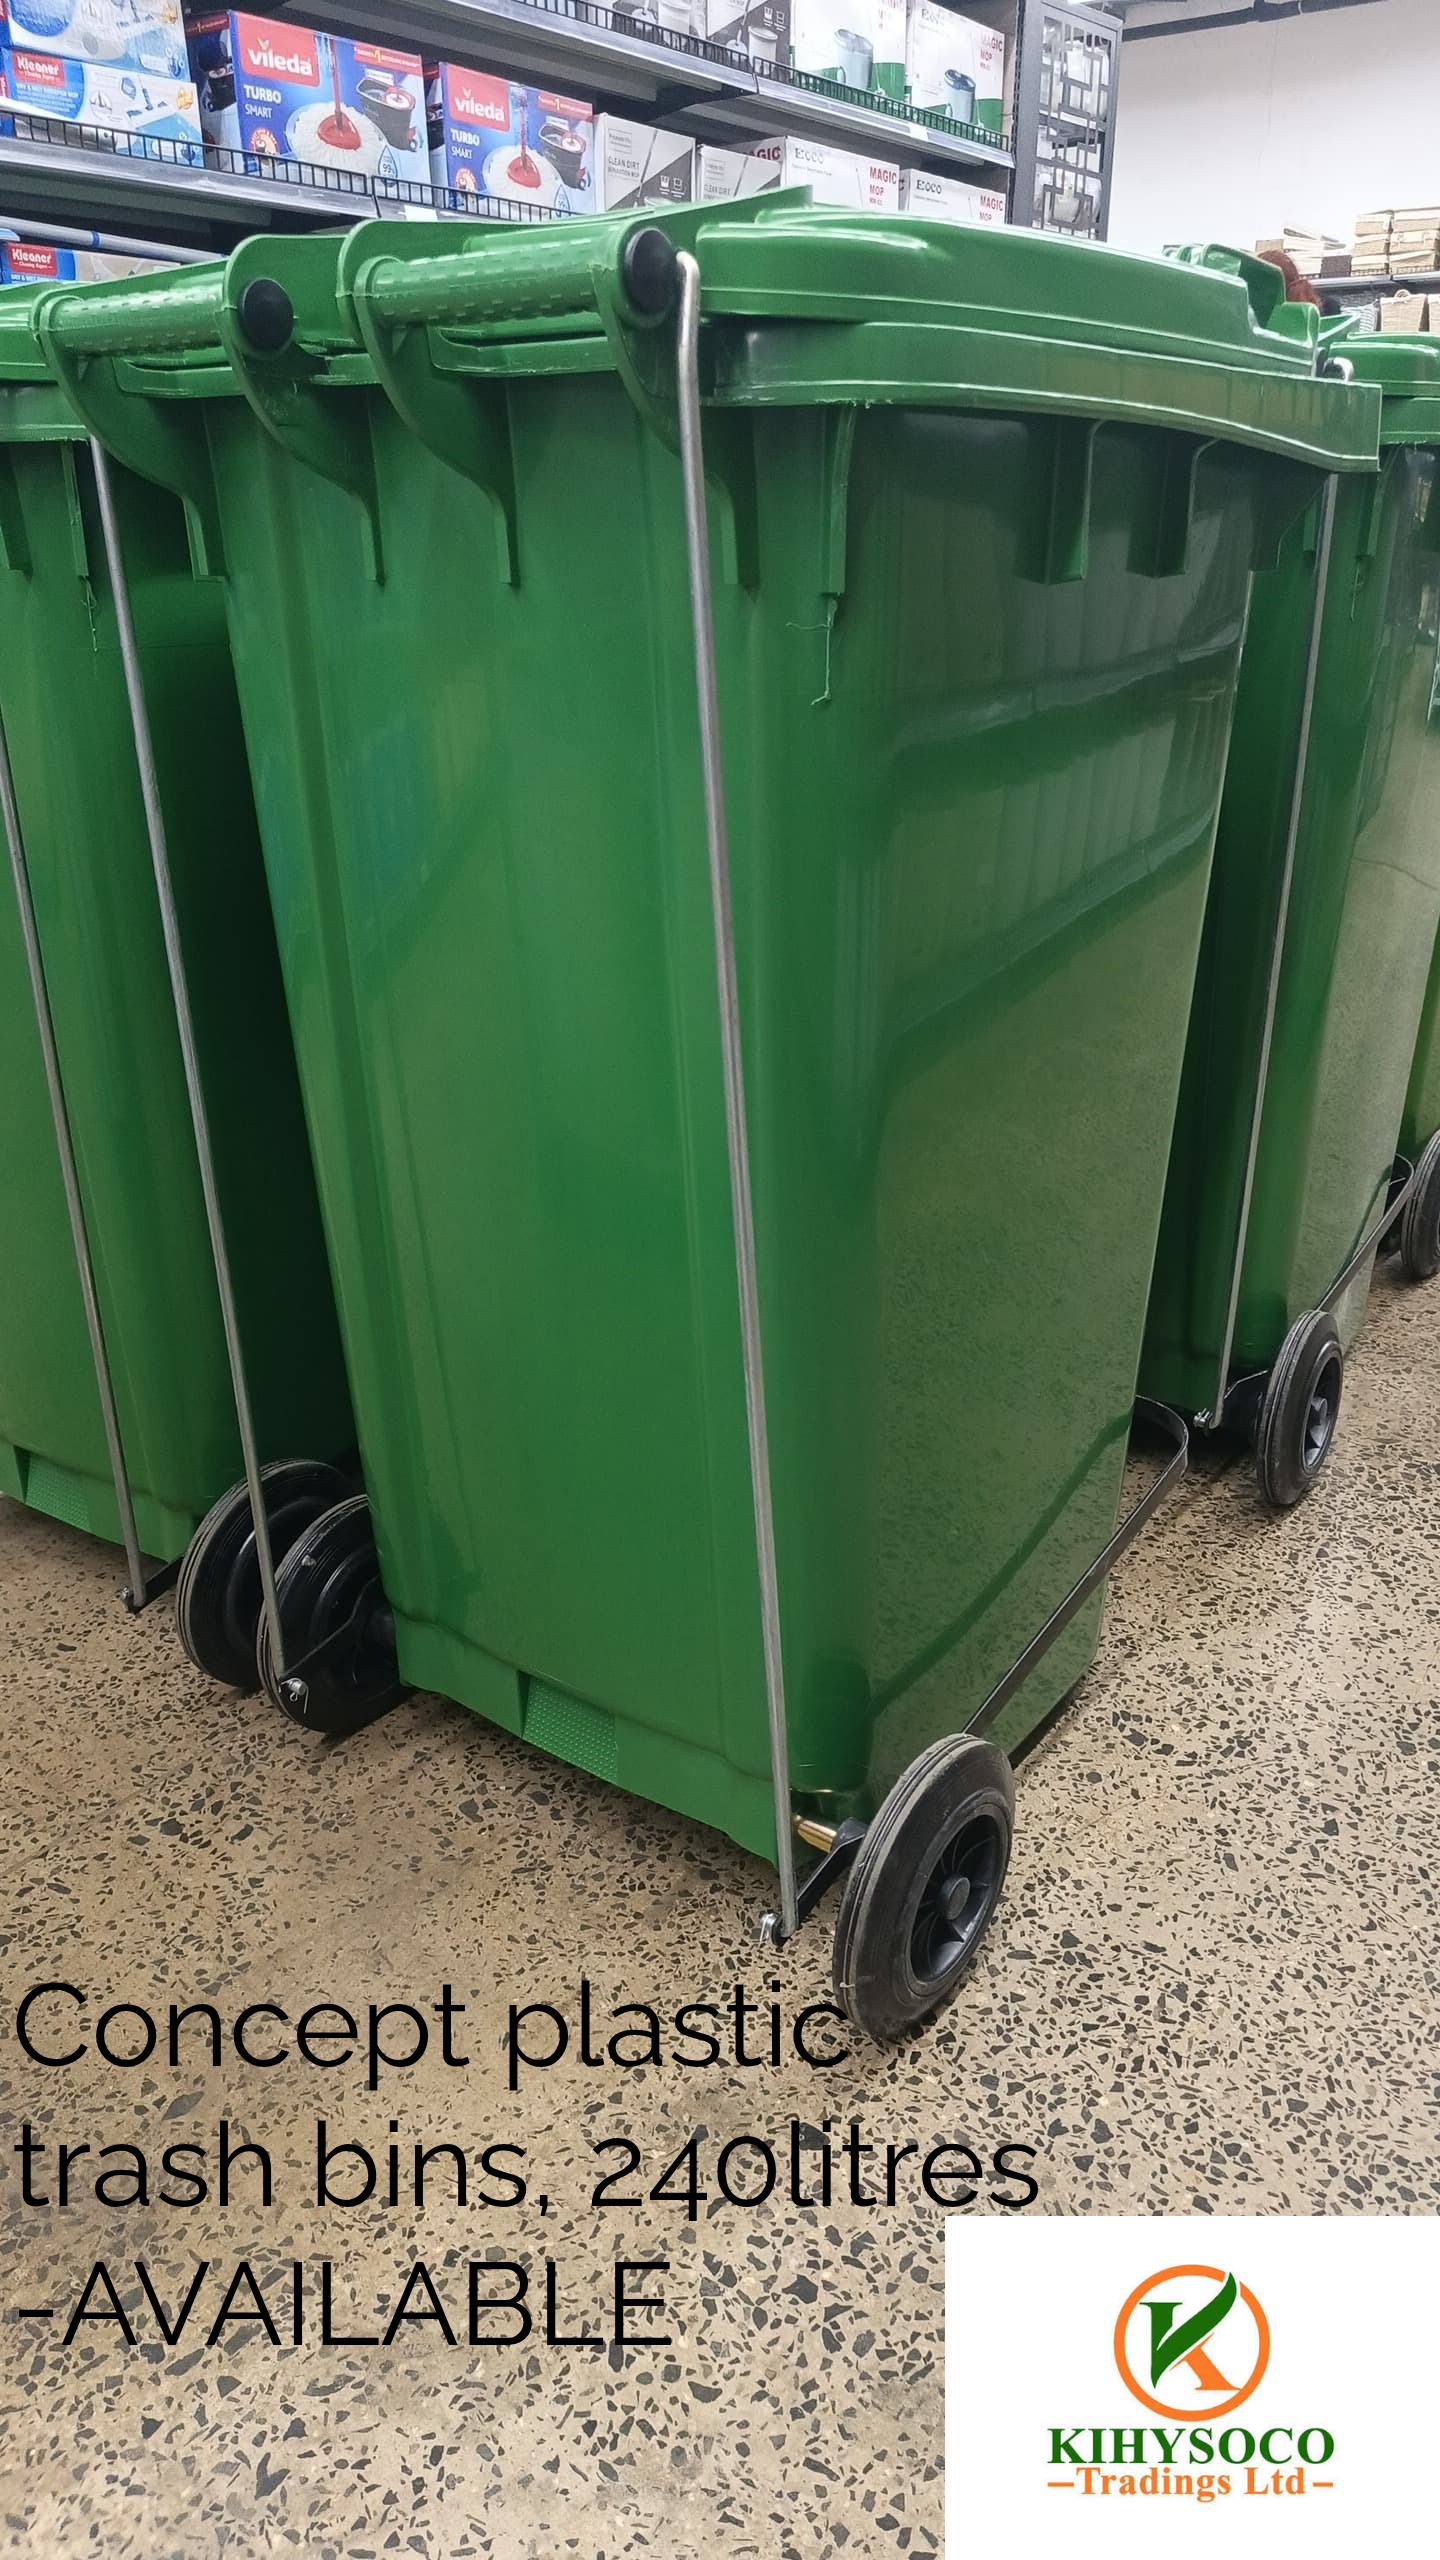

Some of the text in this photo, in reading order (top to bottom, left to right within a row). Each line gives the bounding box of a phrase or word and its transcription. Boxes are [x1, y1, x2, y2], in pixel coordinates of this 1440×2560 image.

[17, 56, 59, 75] Kleaner
[247, 41, 313, 76] vileda
[243, 83, 282, 105] TURBO
[244, 103, 273, 119] SMART
[454, 90, 505, 122] vileda
[450, 127, 480, 147] TURBO
[451, 145, 473, 160] SMART
[607, 155, 641, 170] CLEAN DIRT
[869, 165, 897, 185] MAGIC
[869, 184, 884, 196] MOP
[979, 194, 1004, 212] MAGIC
[12, 248, 52, 264] Kleaner
